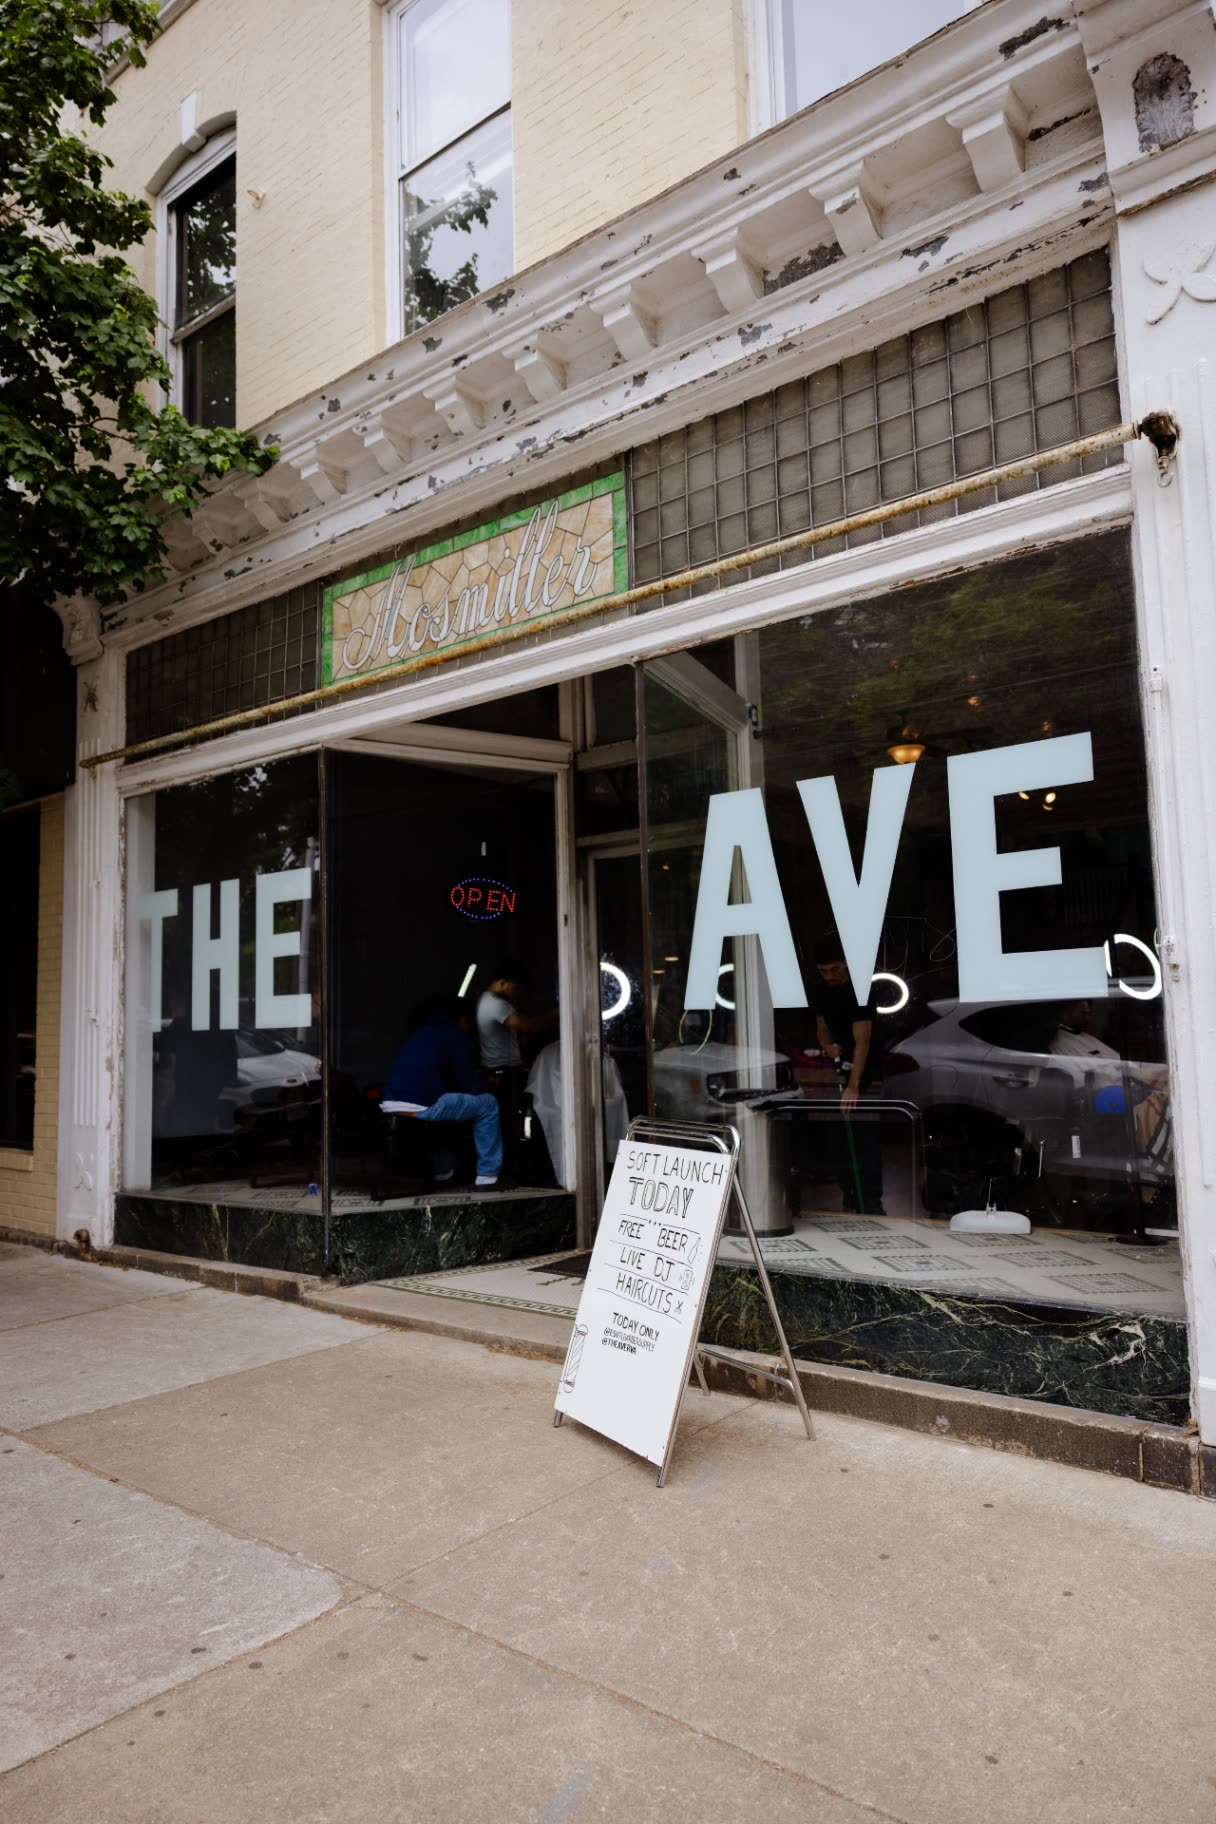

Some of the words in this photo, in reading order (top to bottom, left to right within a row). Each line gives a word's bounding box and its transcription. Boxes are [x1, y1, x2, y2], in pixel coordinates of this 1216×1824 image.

[342, 500, 598, 670] Mosmiller
[135, 867, 312, 1033] THE
[685, 731, 1109, 1009] AVE
[450, 885, 516, 913] OPEN
[627, 1151, 661, 1175] SOFT
[662, 1156, 724, 1186] LAUNCH
[629, 1176, 695, 1219] TODAY
[618, 1220, 645, 1240] FREE
[657, 1228, 688, 1253] BEER
[620, 1249, 646, 1271] LIVE
[654, 1258, 674, 1281] DJ
[616, 1272, 673, 1314] HAIRCUTS
[613, 1312, 639, 1333] TODAY
[639, 1325, 660, 1341] ONLY
